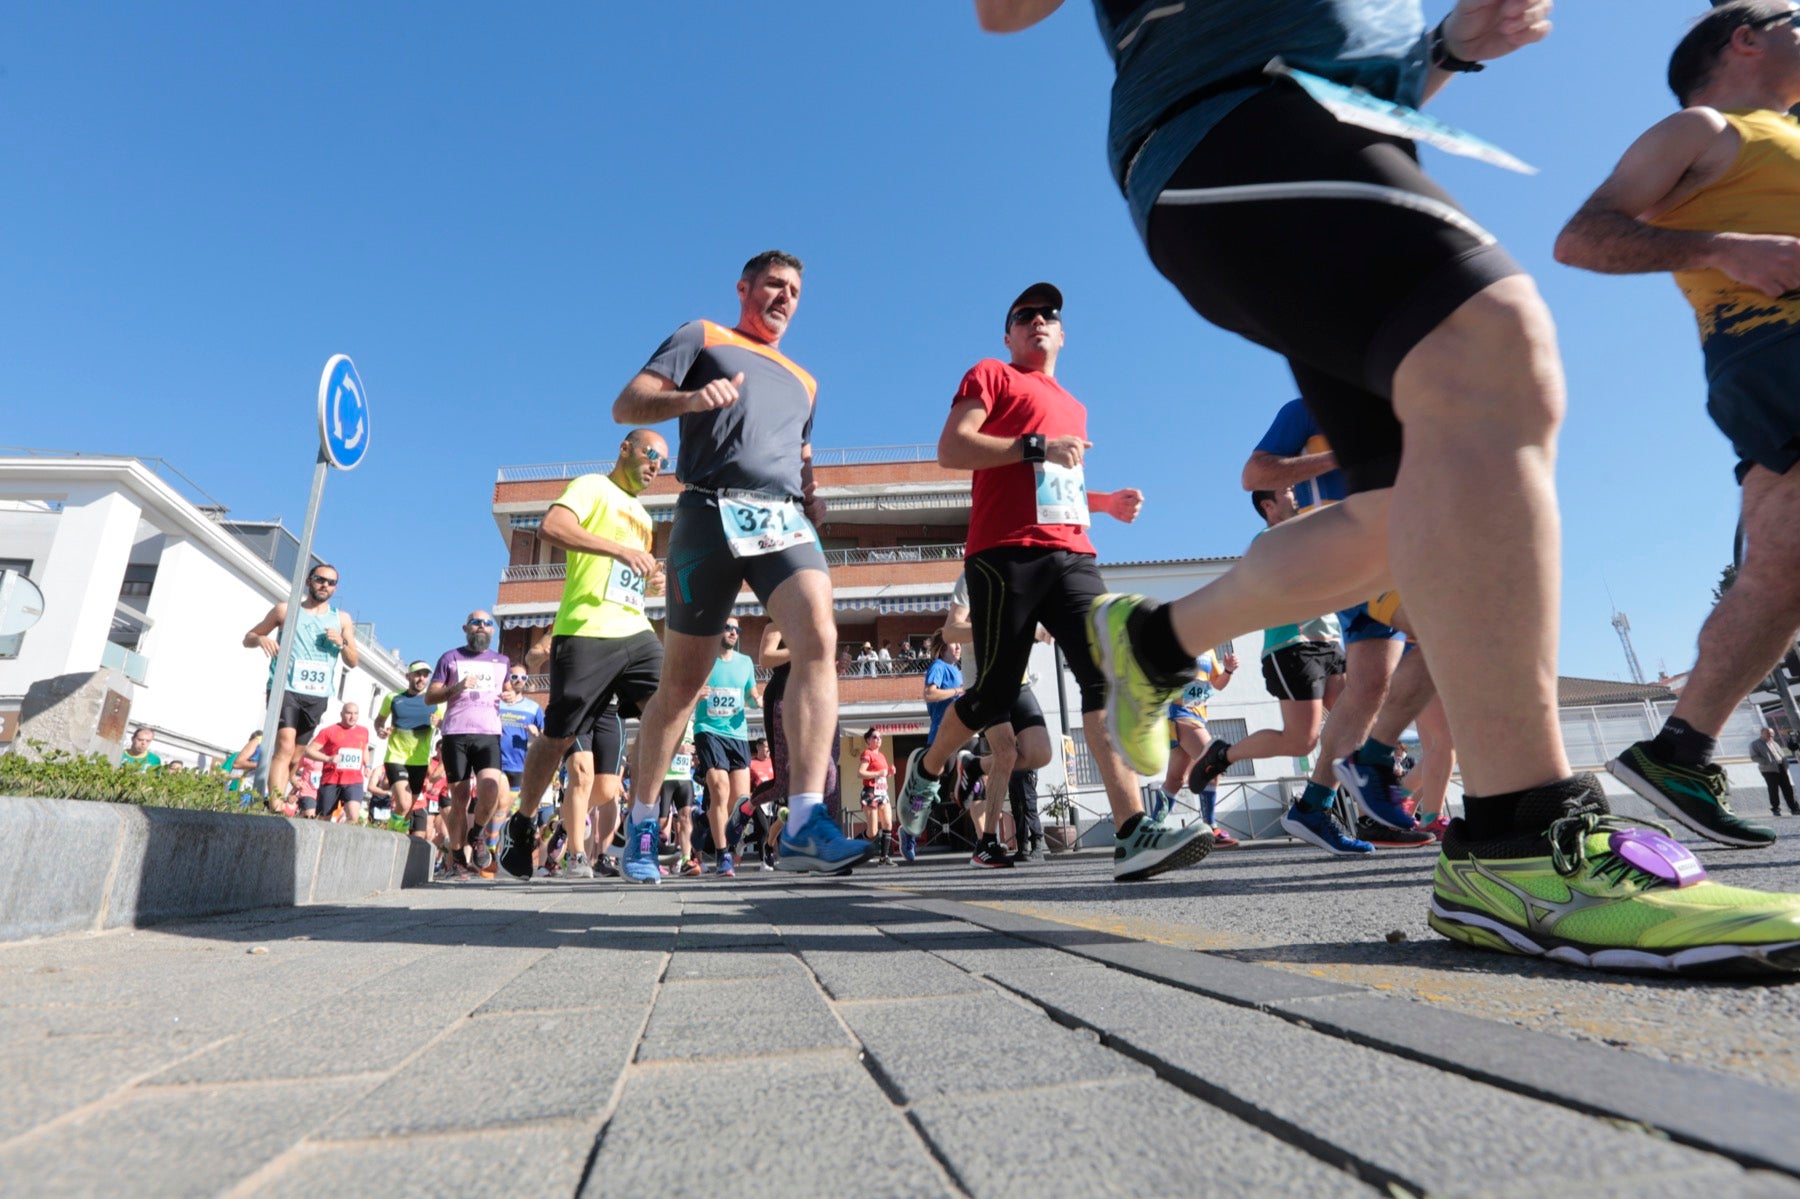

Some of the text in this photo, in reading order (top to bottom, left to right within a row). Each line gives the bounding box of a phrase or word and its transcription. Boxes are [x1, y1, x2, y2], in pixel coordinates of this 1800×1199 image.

[737, 508, 789, 531] 321
[301, 669, 325, 683] 933
[1188, 686, 1210, 700] 485
[712, 696, 735, 707] 922
[340, 754, 361, 763] 1001
